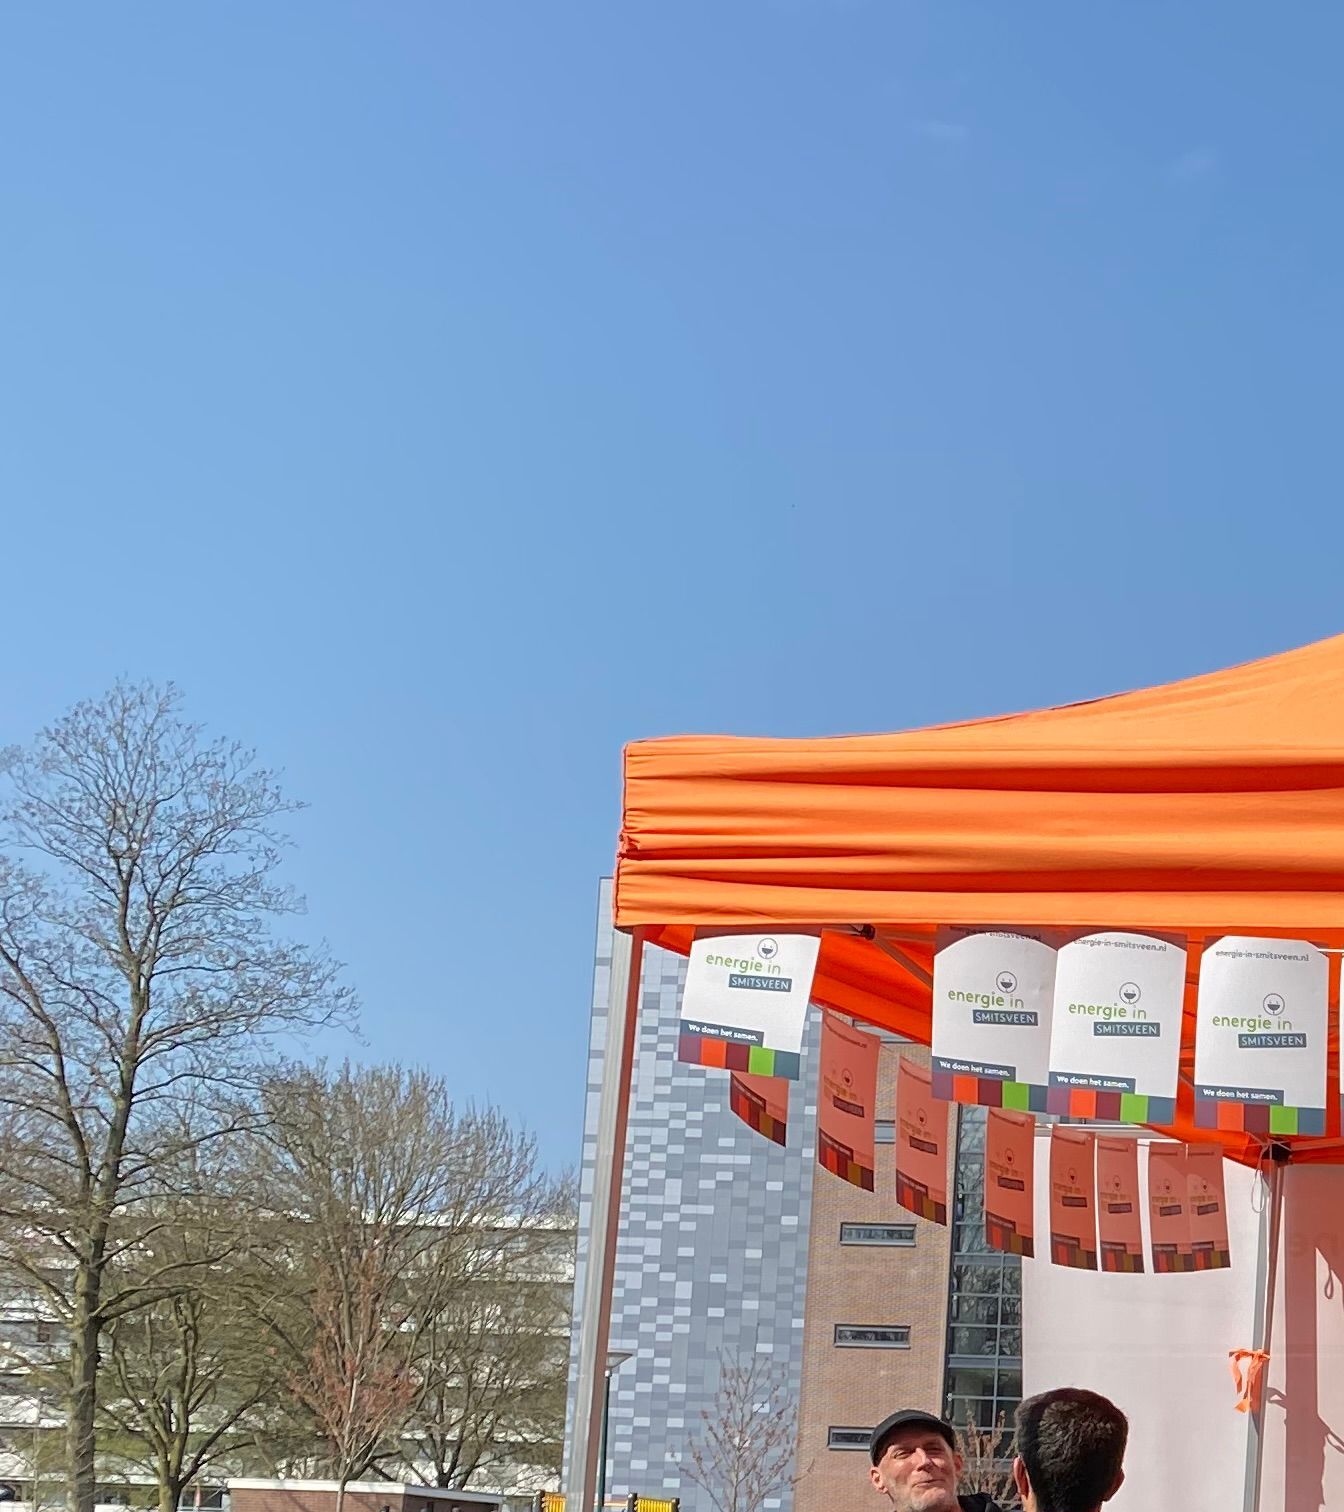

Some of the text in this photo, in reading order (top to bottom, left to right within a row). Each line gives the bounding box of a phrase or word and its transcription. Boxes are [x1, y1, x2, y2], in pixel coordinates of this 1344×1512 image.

[1215, 950, 1310, 962] energie-in-smitsveen.nl
[706, 954, 781, 975] energie in
[731, 976, 790, 990] SMITSVEEN
[948, 989, 1024, 1009] energie in
[1069, 1002, 1147, 1020] energie in
[975, 1012, 1035, 1024] SMITSVEEN
[1212, 1014, 1292, 1032] energie in
[1096, 1024, 1157, 1035] SMITSVEEN
[1241, 1036, 1304, 1046] SMITSVEEN
[939, 1061, 951, 1069] We
[952, 1062, 969, 1072] doen
[971, 1064, 983, 1074] het
[1056, 1075, 1069, 1084] We
[1069, 1077, 1087, 1086] doen
[1089, 1078, 1102, 1087] het
[1203, 1089, 1215, 1097] We
[1217, 1089, 1234, 1098] doen
[1236, 1090, 1249, 1099] het
